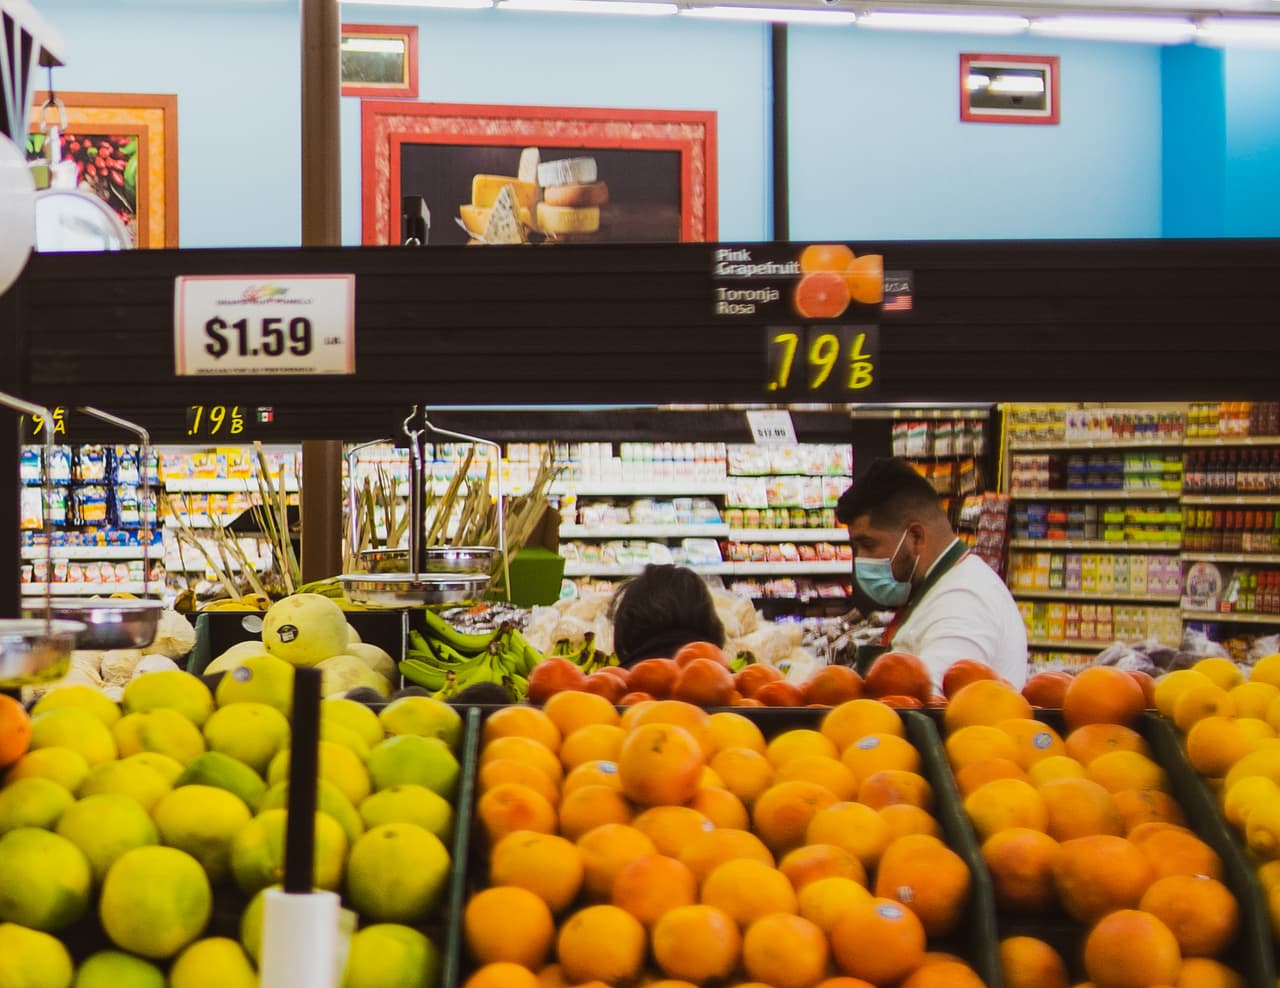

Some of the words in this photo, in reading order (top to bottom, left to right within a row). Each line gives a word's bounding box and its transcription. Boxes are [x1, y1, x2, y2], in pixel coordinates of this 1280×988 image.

[716, 249, 752, 262] Pink
[716, 261, 800, 277] Grapefruit
[716, 287, 780, 303] Toronja
[716, 302, 756, 315] Rosa
[204, 316, 313, 359] $1.59
